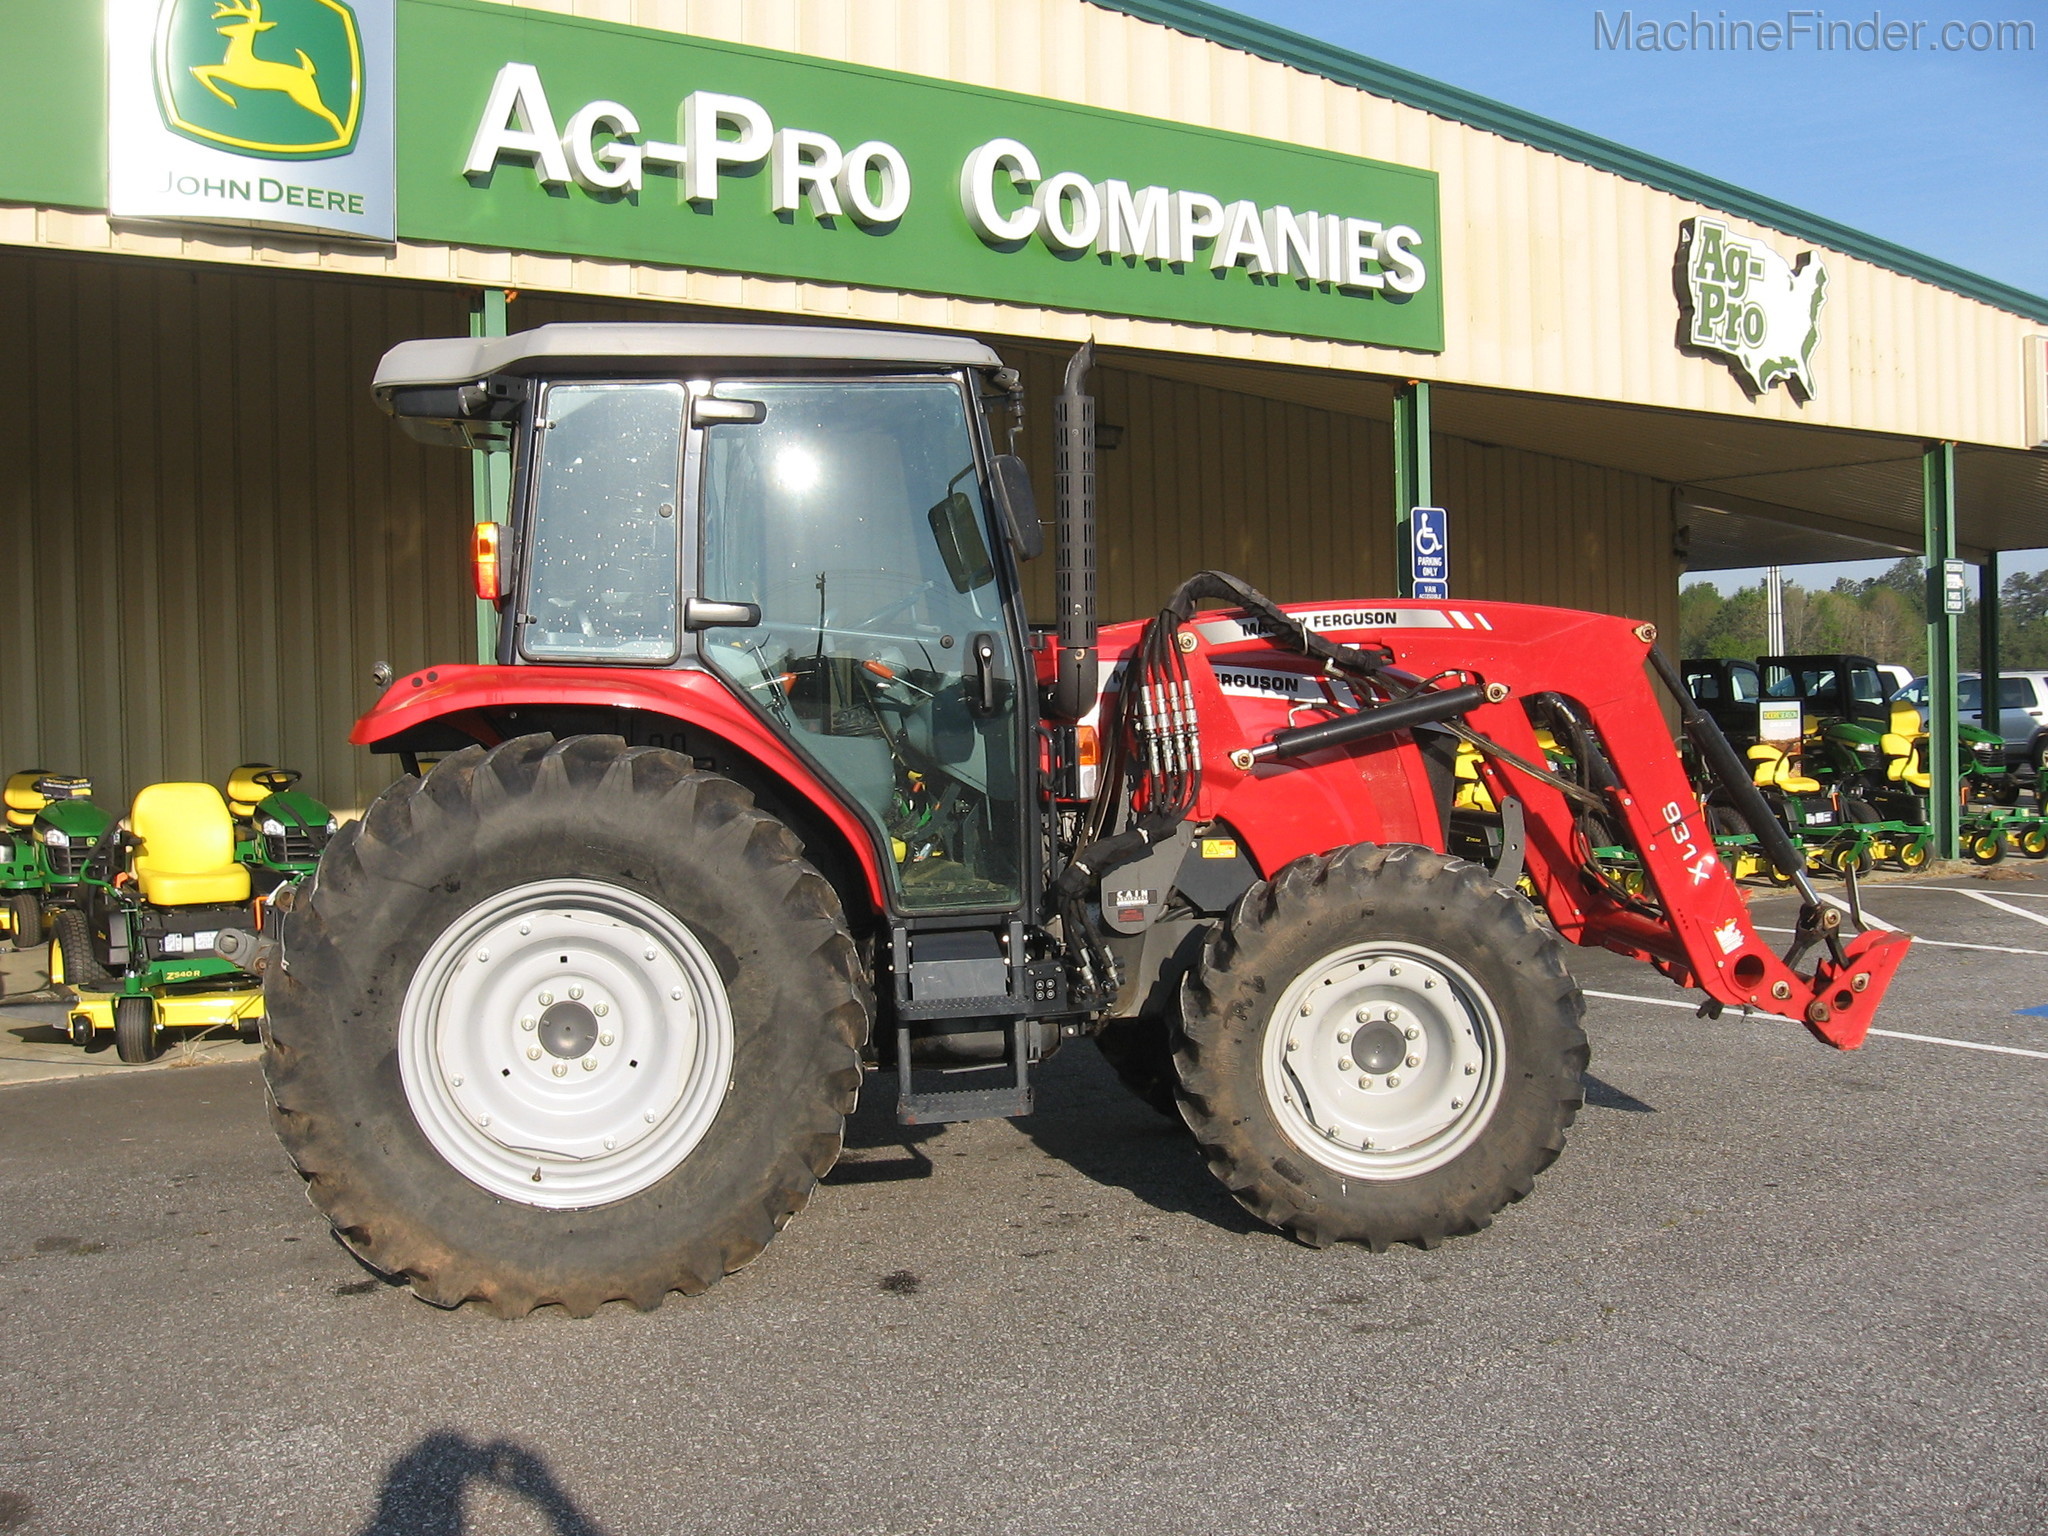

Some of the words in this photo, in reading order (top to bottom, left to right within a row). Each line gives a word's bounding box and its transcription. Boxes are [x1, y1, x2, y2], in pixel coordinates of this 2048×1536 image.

[463, 61, 911, 225] AG-PRO
[960, 137, 1427, 295] COMPANIES
[157, 170, 251, 201] JOHN
[258, 177, 365, 215] DEERE
[1697, 283, 1765, 344] Pro
[1417, 556, 1443, 567] PARKING
[1422, 566, 1439, 577] ONLY
[1313, 611, 1398, 628] FERGUSON
[1116, 889, 1148, 898] CAIN
